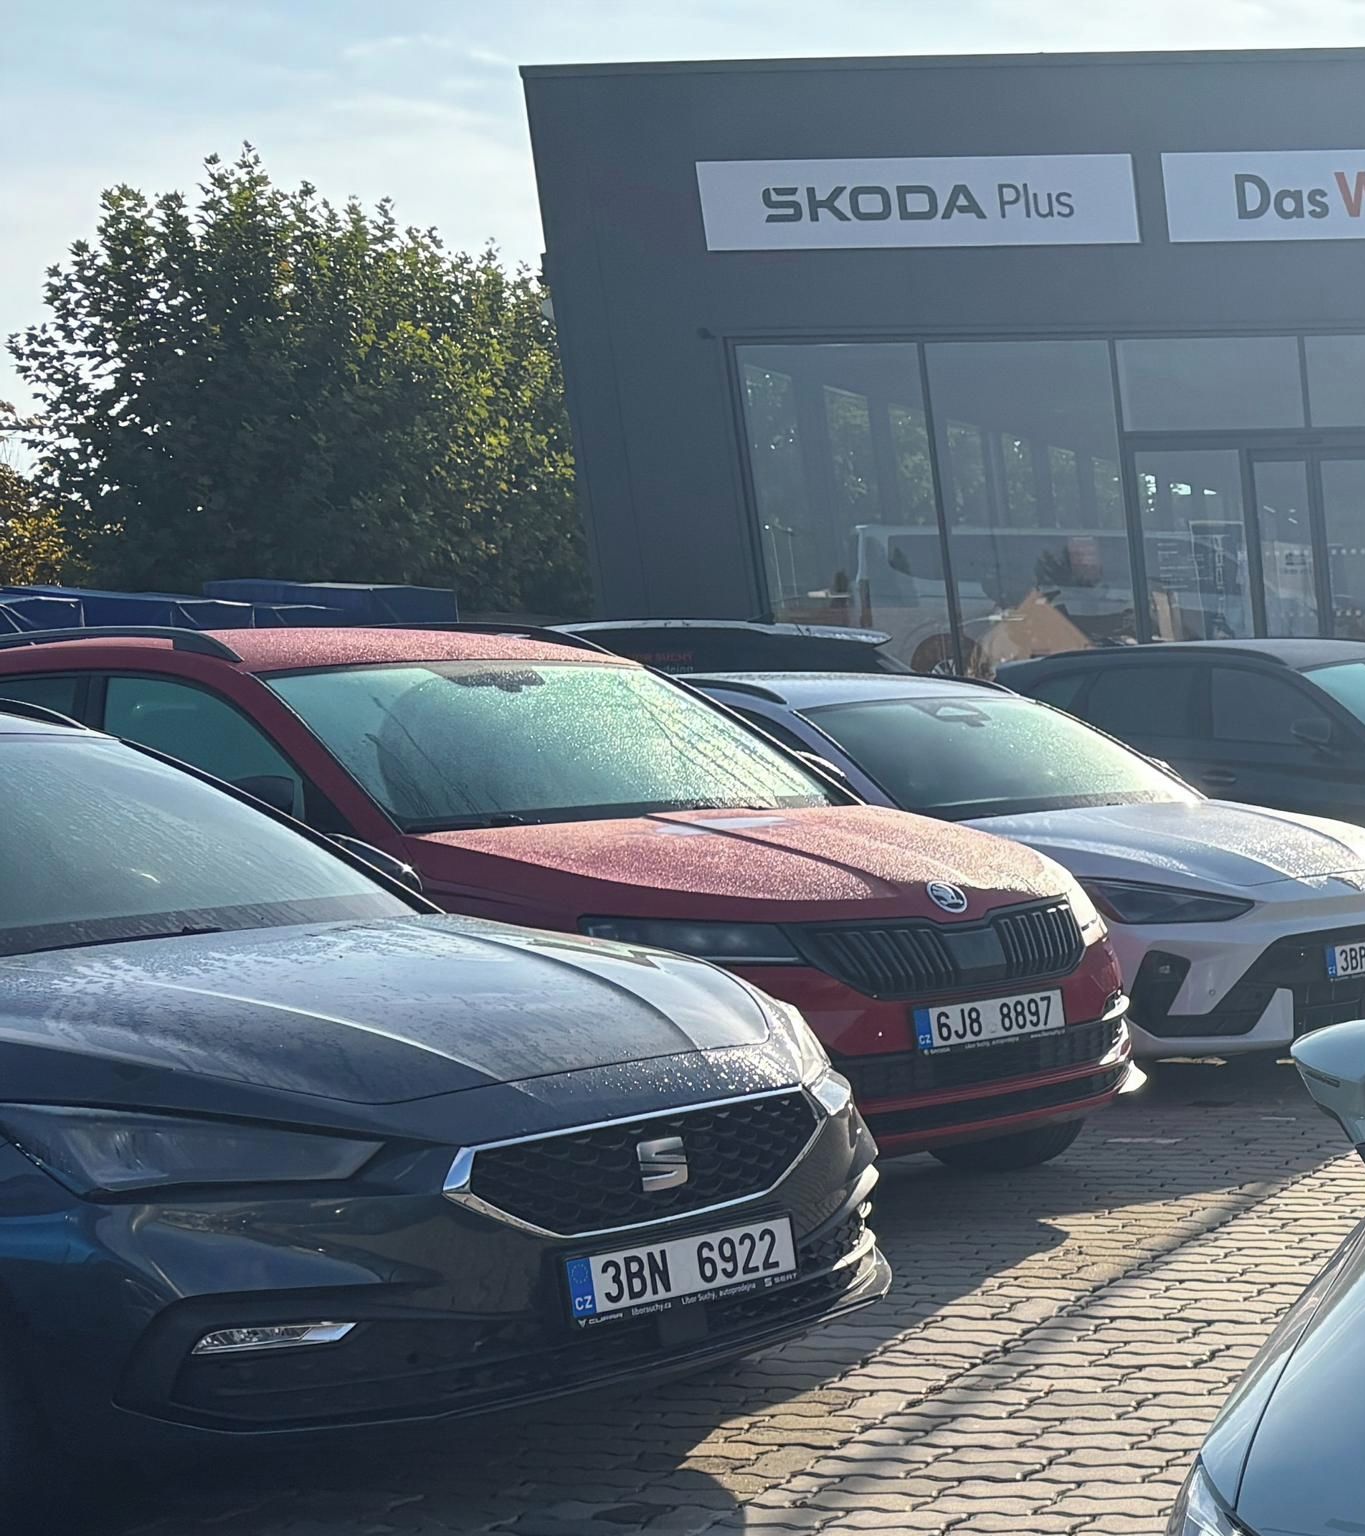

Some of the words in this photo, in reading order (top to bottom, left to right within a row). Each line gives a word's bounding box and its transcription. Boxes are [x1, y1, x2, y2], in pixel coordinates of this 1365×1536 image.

[997, 183, 1075, 219] Plus
[1234, 173, 1330, 220] Das
[936, 1006, 983, 1042] 6J8
[1000, 996, 1052, 1032] 8897
[918, 1034, 932, 1046] CZ
[601, 1248, 672, 1304] 3BN
[697, 1227, 780, 1284] 6922
[575, 1295, 593, 1311] CZ
